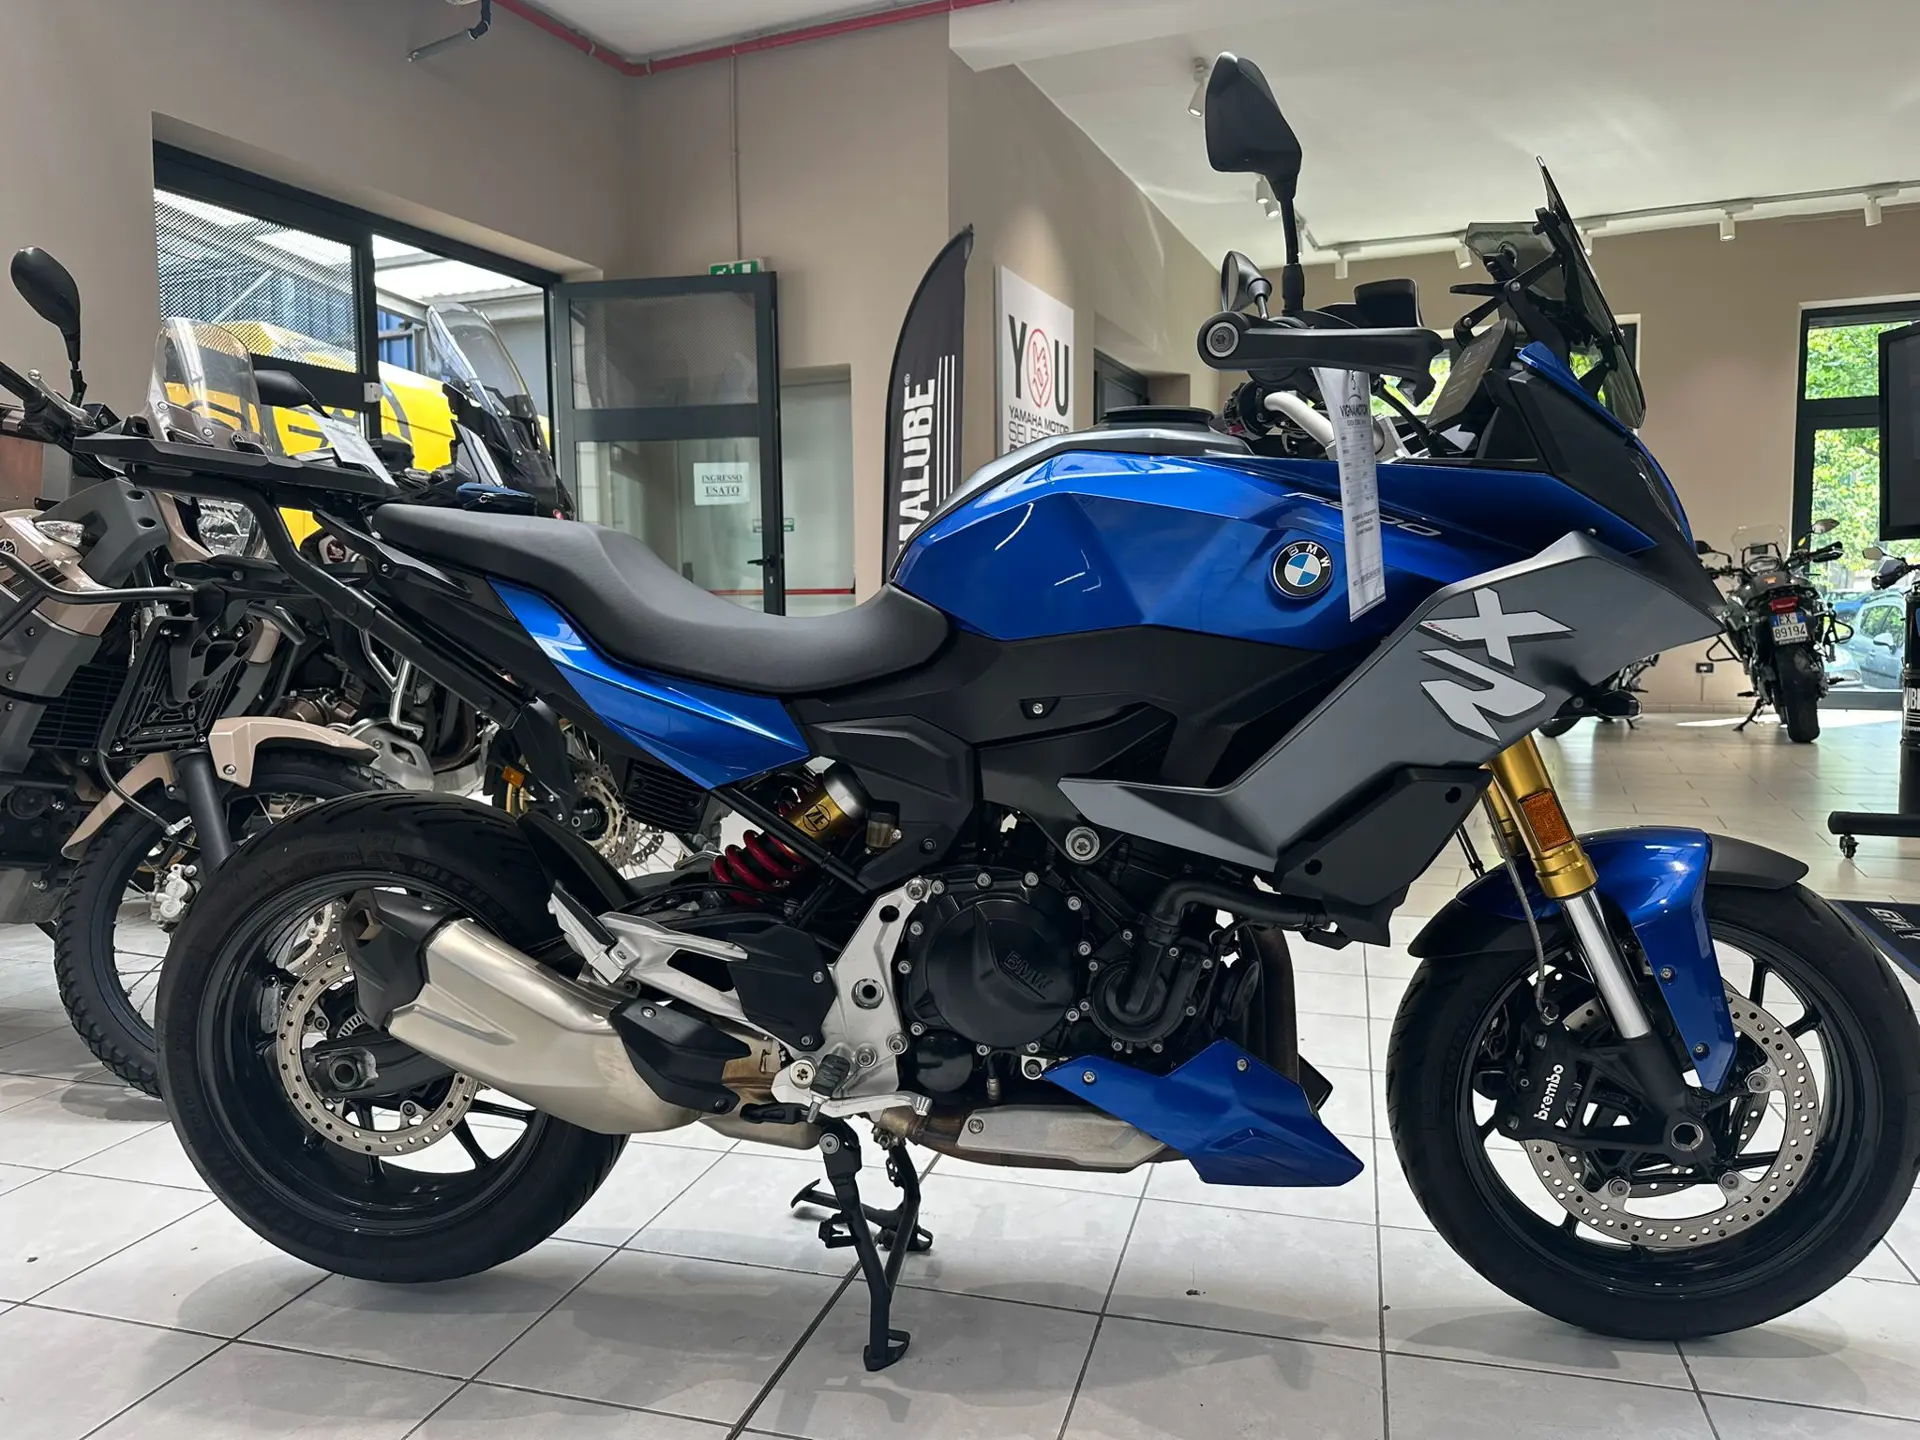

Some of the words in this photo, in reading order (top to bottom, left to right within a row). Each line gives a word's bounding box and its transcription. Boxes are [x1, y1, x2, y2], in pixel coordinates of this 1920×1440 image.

[1009, 404, 1043, 429] YAMAHA
[701, 473, 743, 484] INGRESSO
[705, 485, 741, 497] USATO
[1287, 543, 1331, 568] BMW
[1003, 950, 1053, 990] BMW
[1533, 1064, 1564, 1121] brembo
